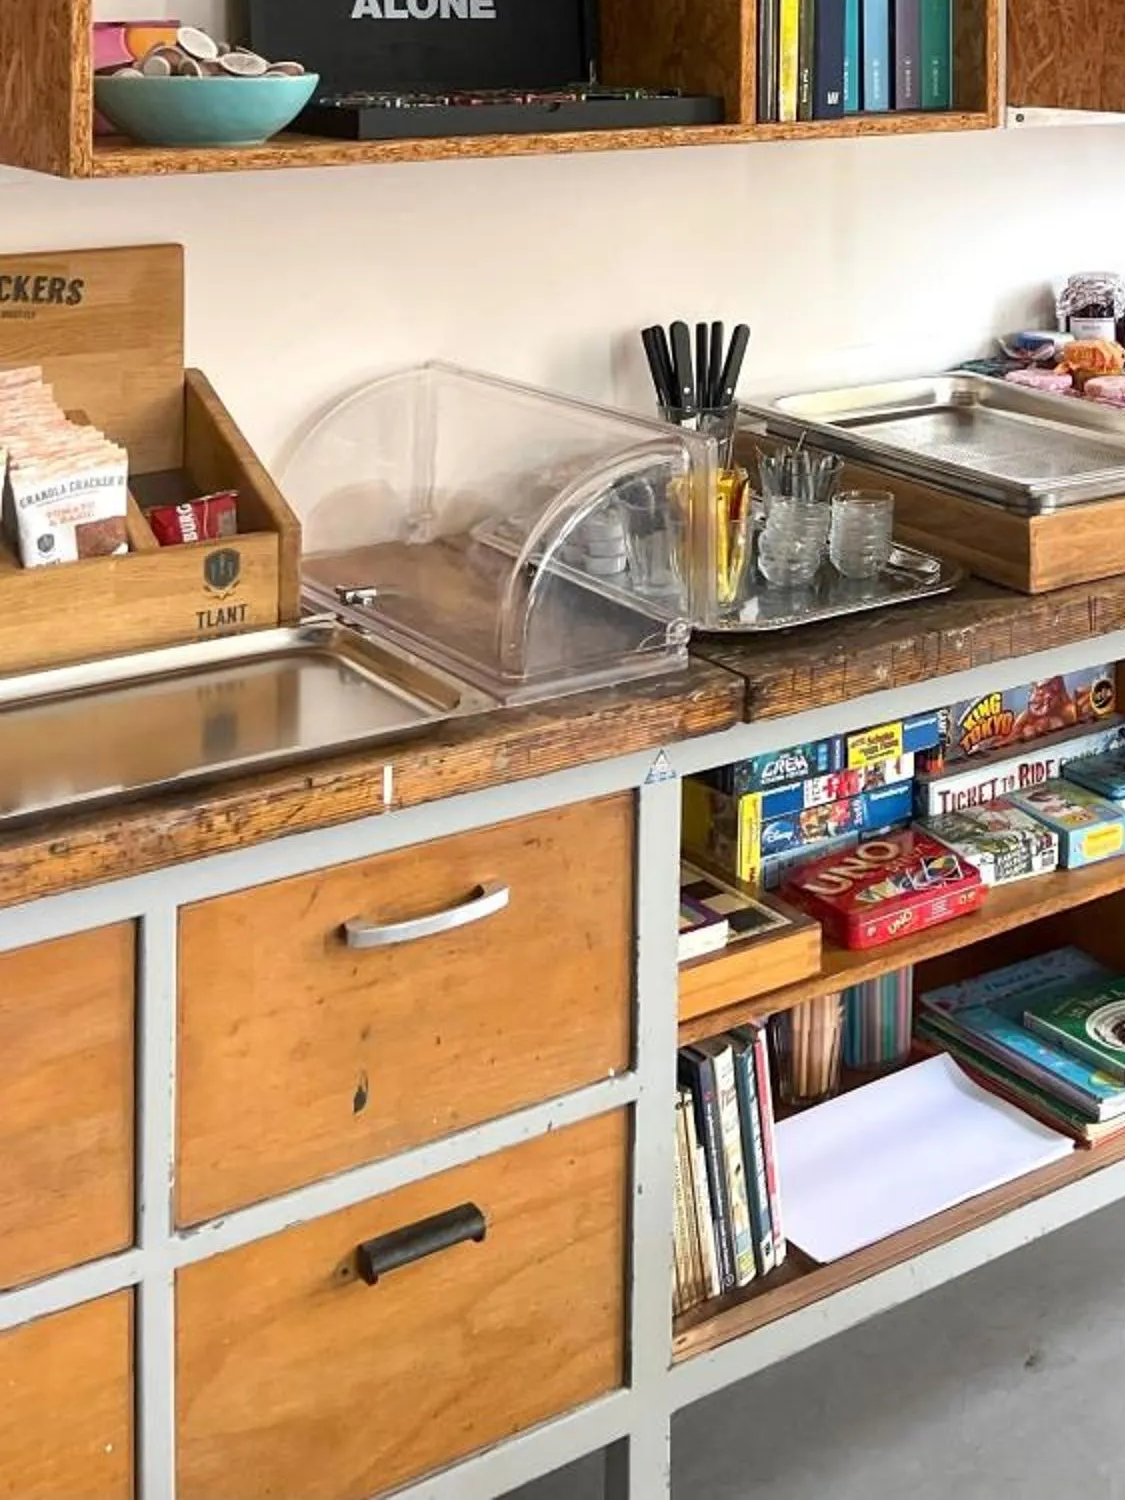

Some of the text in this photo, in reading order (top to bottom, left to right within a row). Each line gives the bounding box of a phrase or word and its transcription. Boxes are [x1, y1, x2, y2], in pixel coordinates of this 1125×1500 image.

[0, 275, 85, 306] CKERS
[195, 603, 249, 629] TLANT
[960, 710, 1014, 752] TOKYO
[963, 693, 1002, 730] KING
[938, 777, 998, 815] TICKET
[1018, 759, 1055, 788] RIDE
[802, 841, 900, 896] UNO
